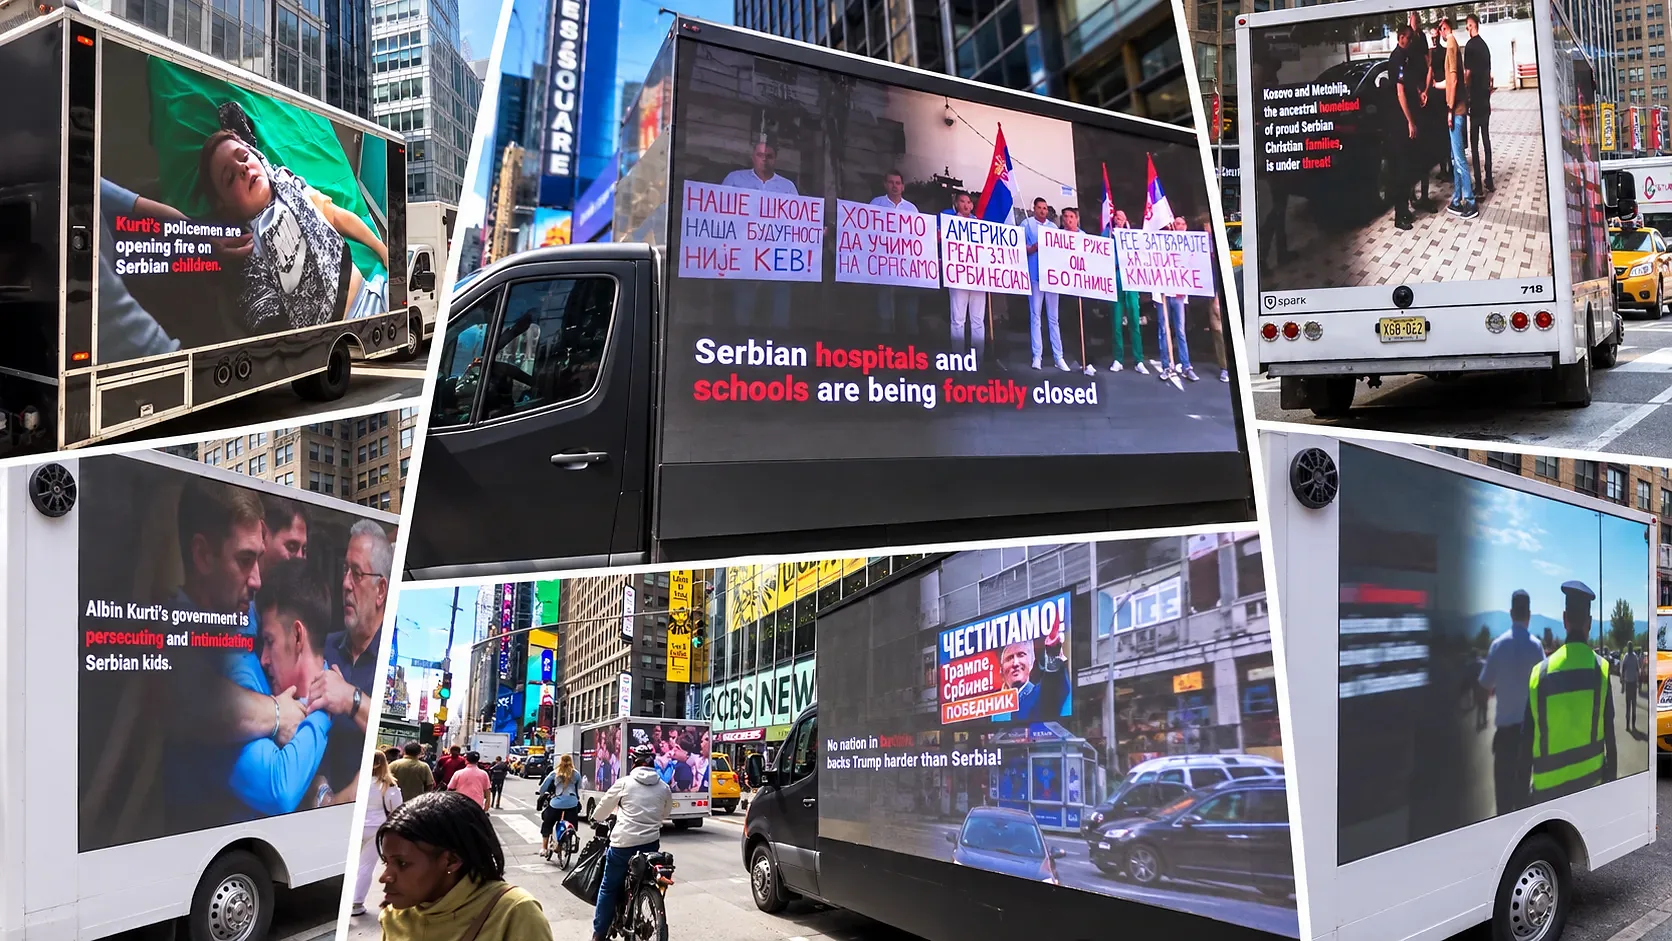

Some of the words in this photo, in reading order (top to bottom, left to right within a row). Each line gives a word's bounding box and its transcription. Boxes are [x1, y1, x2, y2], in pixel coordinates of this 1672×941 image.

[1263, 88, 1293, 100] Kosovo
[1294, 84, 1310, 97] and
[1311, 82, 1351, 97] Metohija,
[1263, 106, 1278, 117] the
[1279, 101, 1317, 117] ancestral
[1264, 123, 1274, 135] of
[1275, 121, 1300, 137] proud
[1301, 119, 1334, 133] Serbian
[1265, 140, 1303, 153] Christian
[1305, 137, 1343, 150] families,
[1266, 159, 1274, 171] is
[1276, 158, 1300, 171] under
[1302, 155, 1331, 169] threat!
[688, 187, 750, 216] НАШЕ
[760, 196, 820, 222] ШКОЛЕ
[164, 220, 223, 237] policemen
[225, 227, 241, 237] are
[686, 217, 737, 240] НАША
[946, 219, 1018, 247] АМЕРИКО
[116, 238, 171, 257] opening
[174, 239, 195, 254] fire
[197, 243, 212, 254] on
[839, 231, 862, 252] ДА
[868, 234, 923, 256] УЧИМО
[116, 258, 169, 274] Serbian
[172, 257, 222, 273] children.
[754, 247, 813, 273] КЕВ!
[839, 254, 860, 273] НА
[1520, 284, 1543, 294] 718
[1278, 296, 1306, 307] spark
[695, 338, 807, 366] Serbian
[816, 341, 928, 375] hospitals
[936, 348, 977, 372] and
[693, 373, 809, 401] schools
[817, 382, 860, 402] are
[868, 376, 936, 409] being
[943, 378, 1027, 410] forcibly
[1033, 380, 1098, 405] closed
[85, 600, 123, 619] Albin
[171, 609, 237, 626] government
[239, 612, 249, 626] is
[943, 597, 1065, 659] ЧЕСТИТАМО!
[85, 629, 164, 649] persecuting
[166, 631, 189, 646] and
[191, 631, 254, 652] intimidating
[85, 654, 139, 671] Serbian
[142, 654, 172, 671] kids.
[942, 656, 994, 683] Трампе,
[944, 670, 994, 702] Србине!
[717, 683, 754, 722] CBS
[946, 693, 1014, 719] ПОБЕДНИК
[827, 739, 838, 751] No
[840, 737, 866, 751] nation
[869, 735, 878, 749] in
[827, 756, 851, 769] backs
[852, 755, 882, 771] Trump
[884, 753, 918, 768] harder
[921, 752, 948, 767] than
[951, 748, 1002, 767] Serbia!
